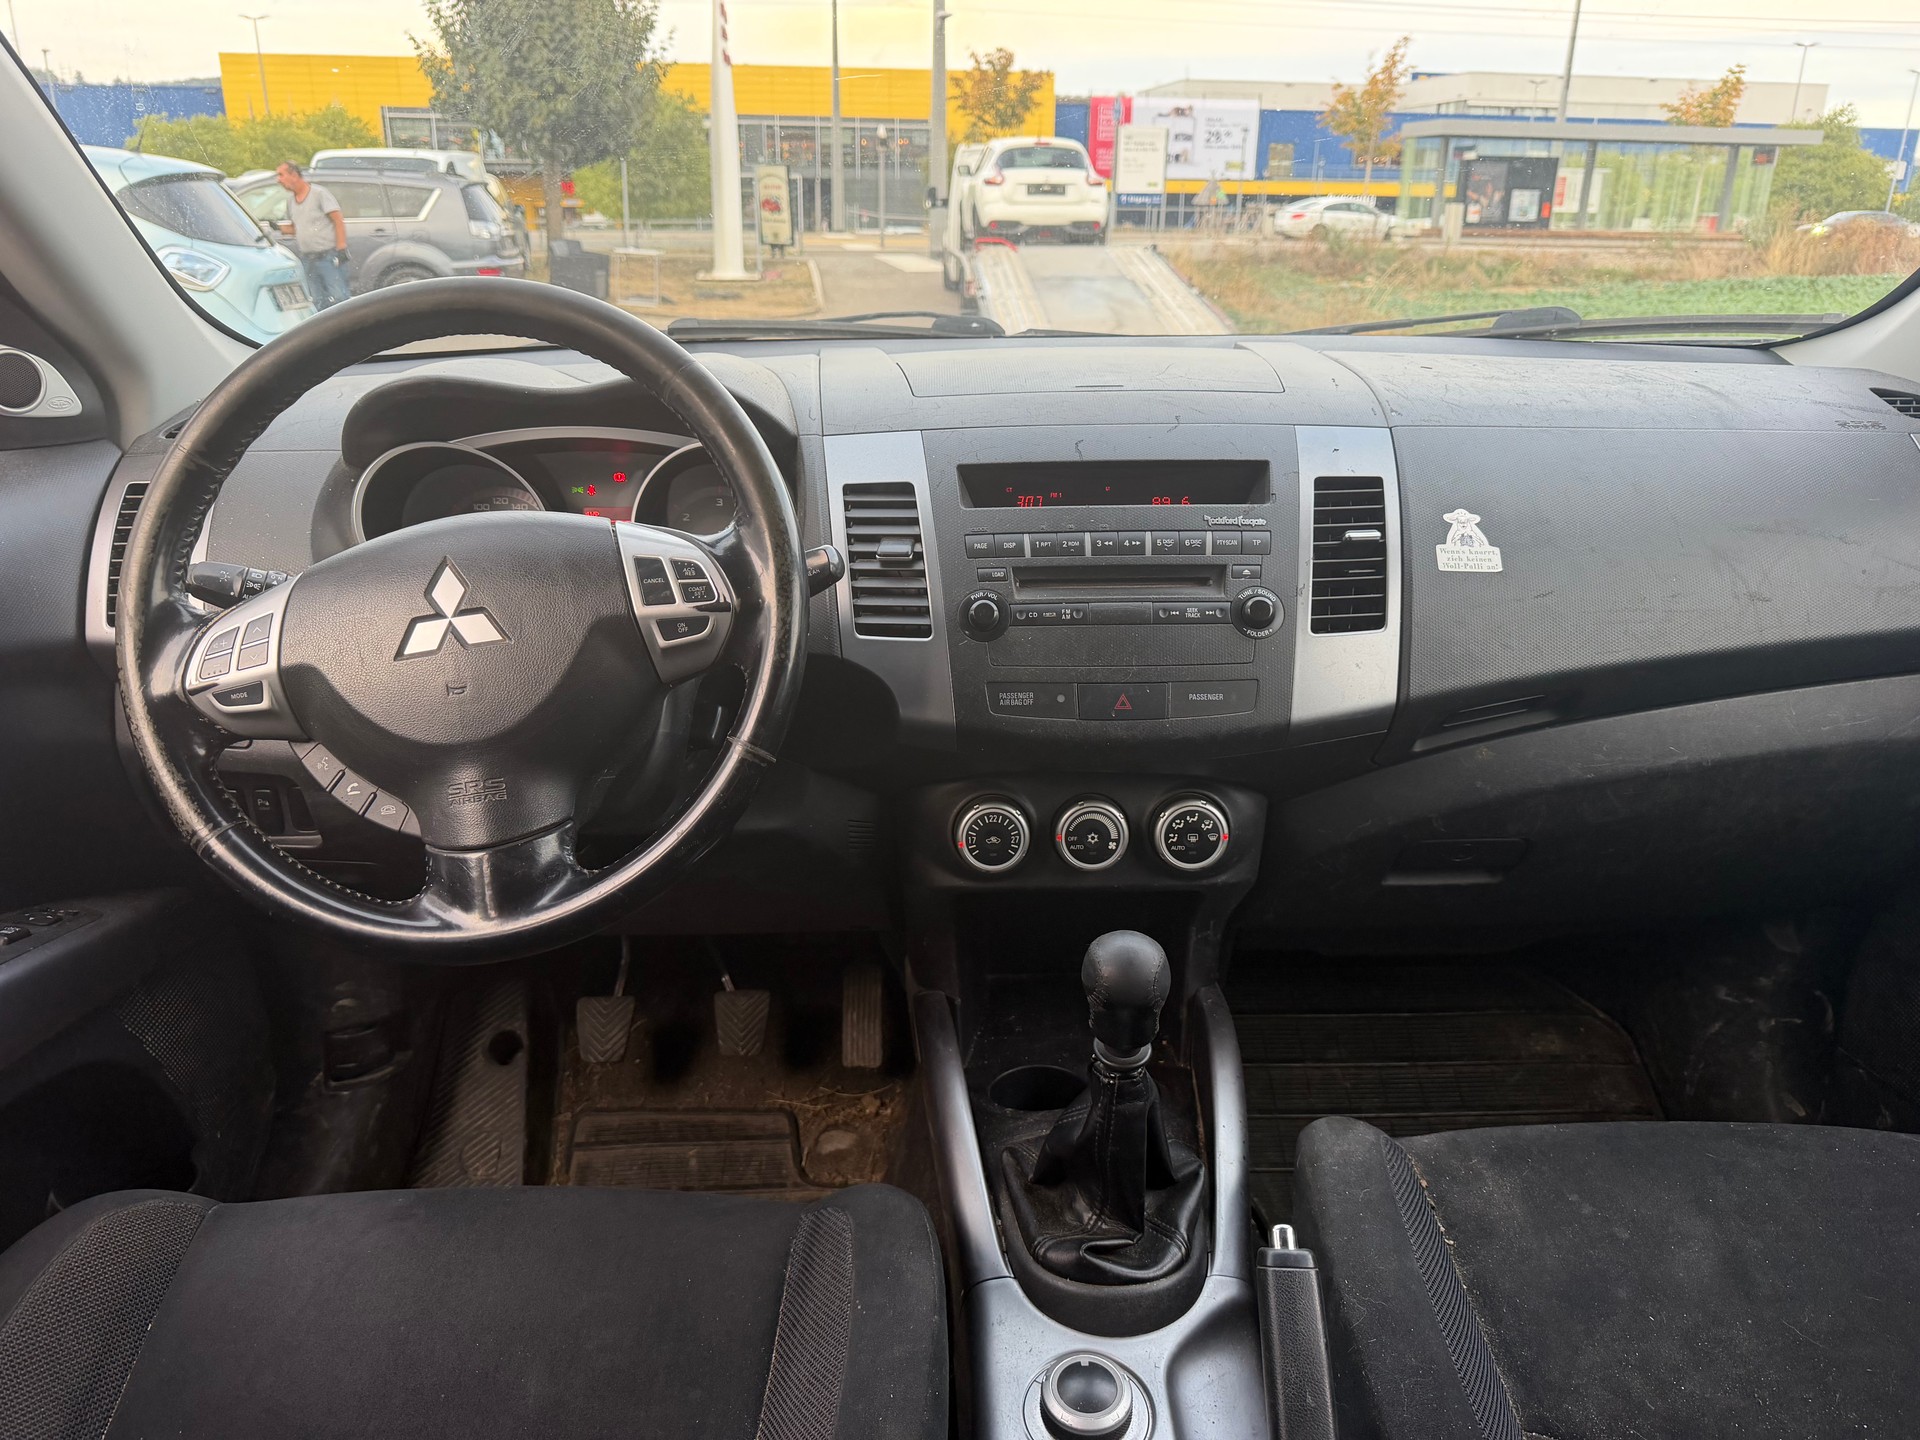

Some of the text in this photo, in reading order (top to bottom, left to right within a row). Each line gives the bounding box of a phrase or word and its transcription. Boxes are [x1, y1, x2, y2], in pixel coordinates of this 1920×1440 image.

[492, 497, 509, 505] 120
[716, 498, 723, 506] 3
[473, 503, 490, 511] 100
[511, 503, 529, 511] 140
[683, 513, 690, 521] 2
[230, 691, 248, 700] MODE
[1188, 693, 1224, 701] PASSENGER
[1023, 698, 1034, 706] OFF
[448, 777, 507, 797] SRS
[968, 836, 977, 844] 17
